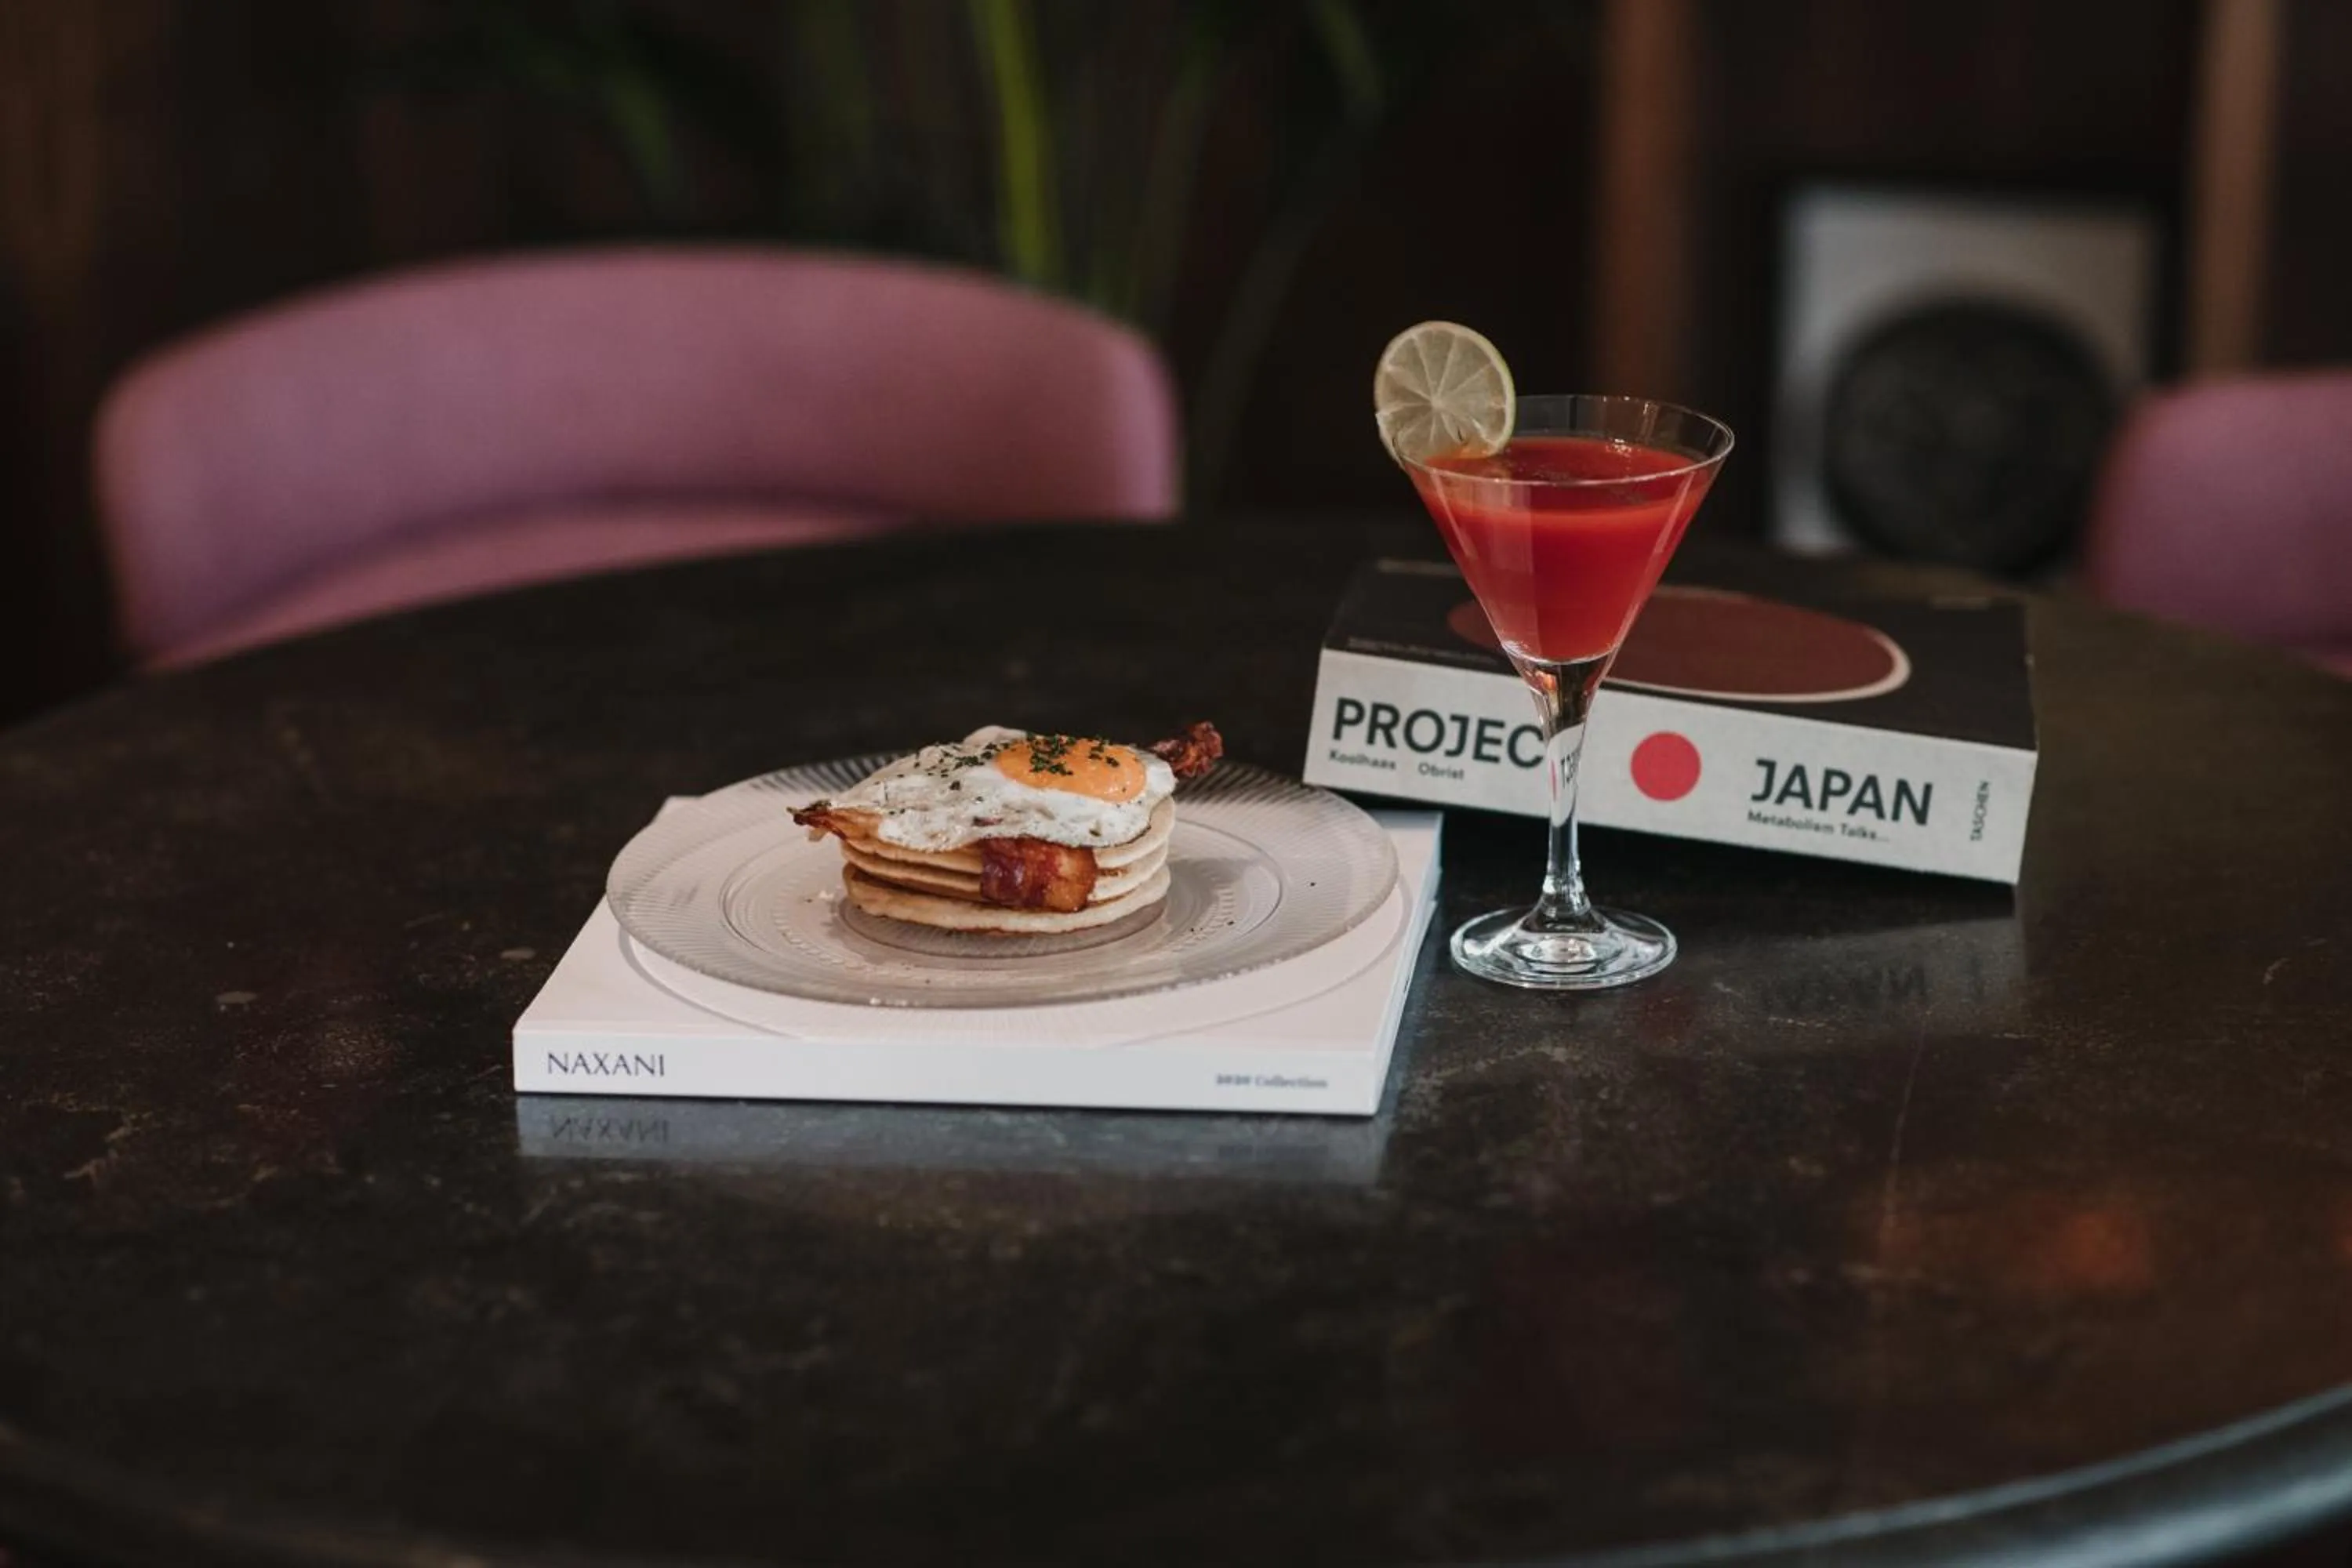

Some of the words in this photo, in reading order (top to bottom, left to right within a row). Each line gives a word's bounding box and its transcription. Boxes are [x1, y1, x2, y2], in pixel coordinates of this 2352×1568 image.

[1329, 749, 1397, 771] Koolhaas
[1418, 760, 1465, 780] Obrist
[1332, 697, 1544, 769] PROJEC
[1751, 758, 1933, 826] JAPAN
[1748, 809, 1835, 835] Metabolism
[547, 1052, 665, 1076] NAXANI
